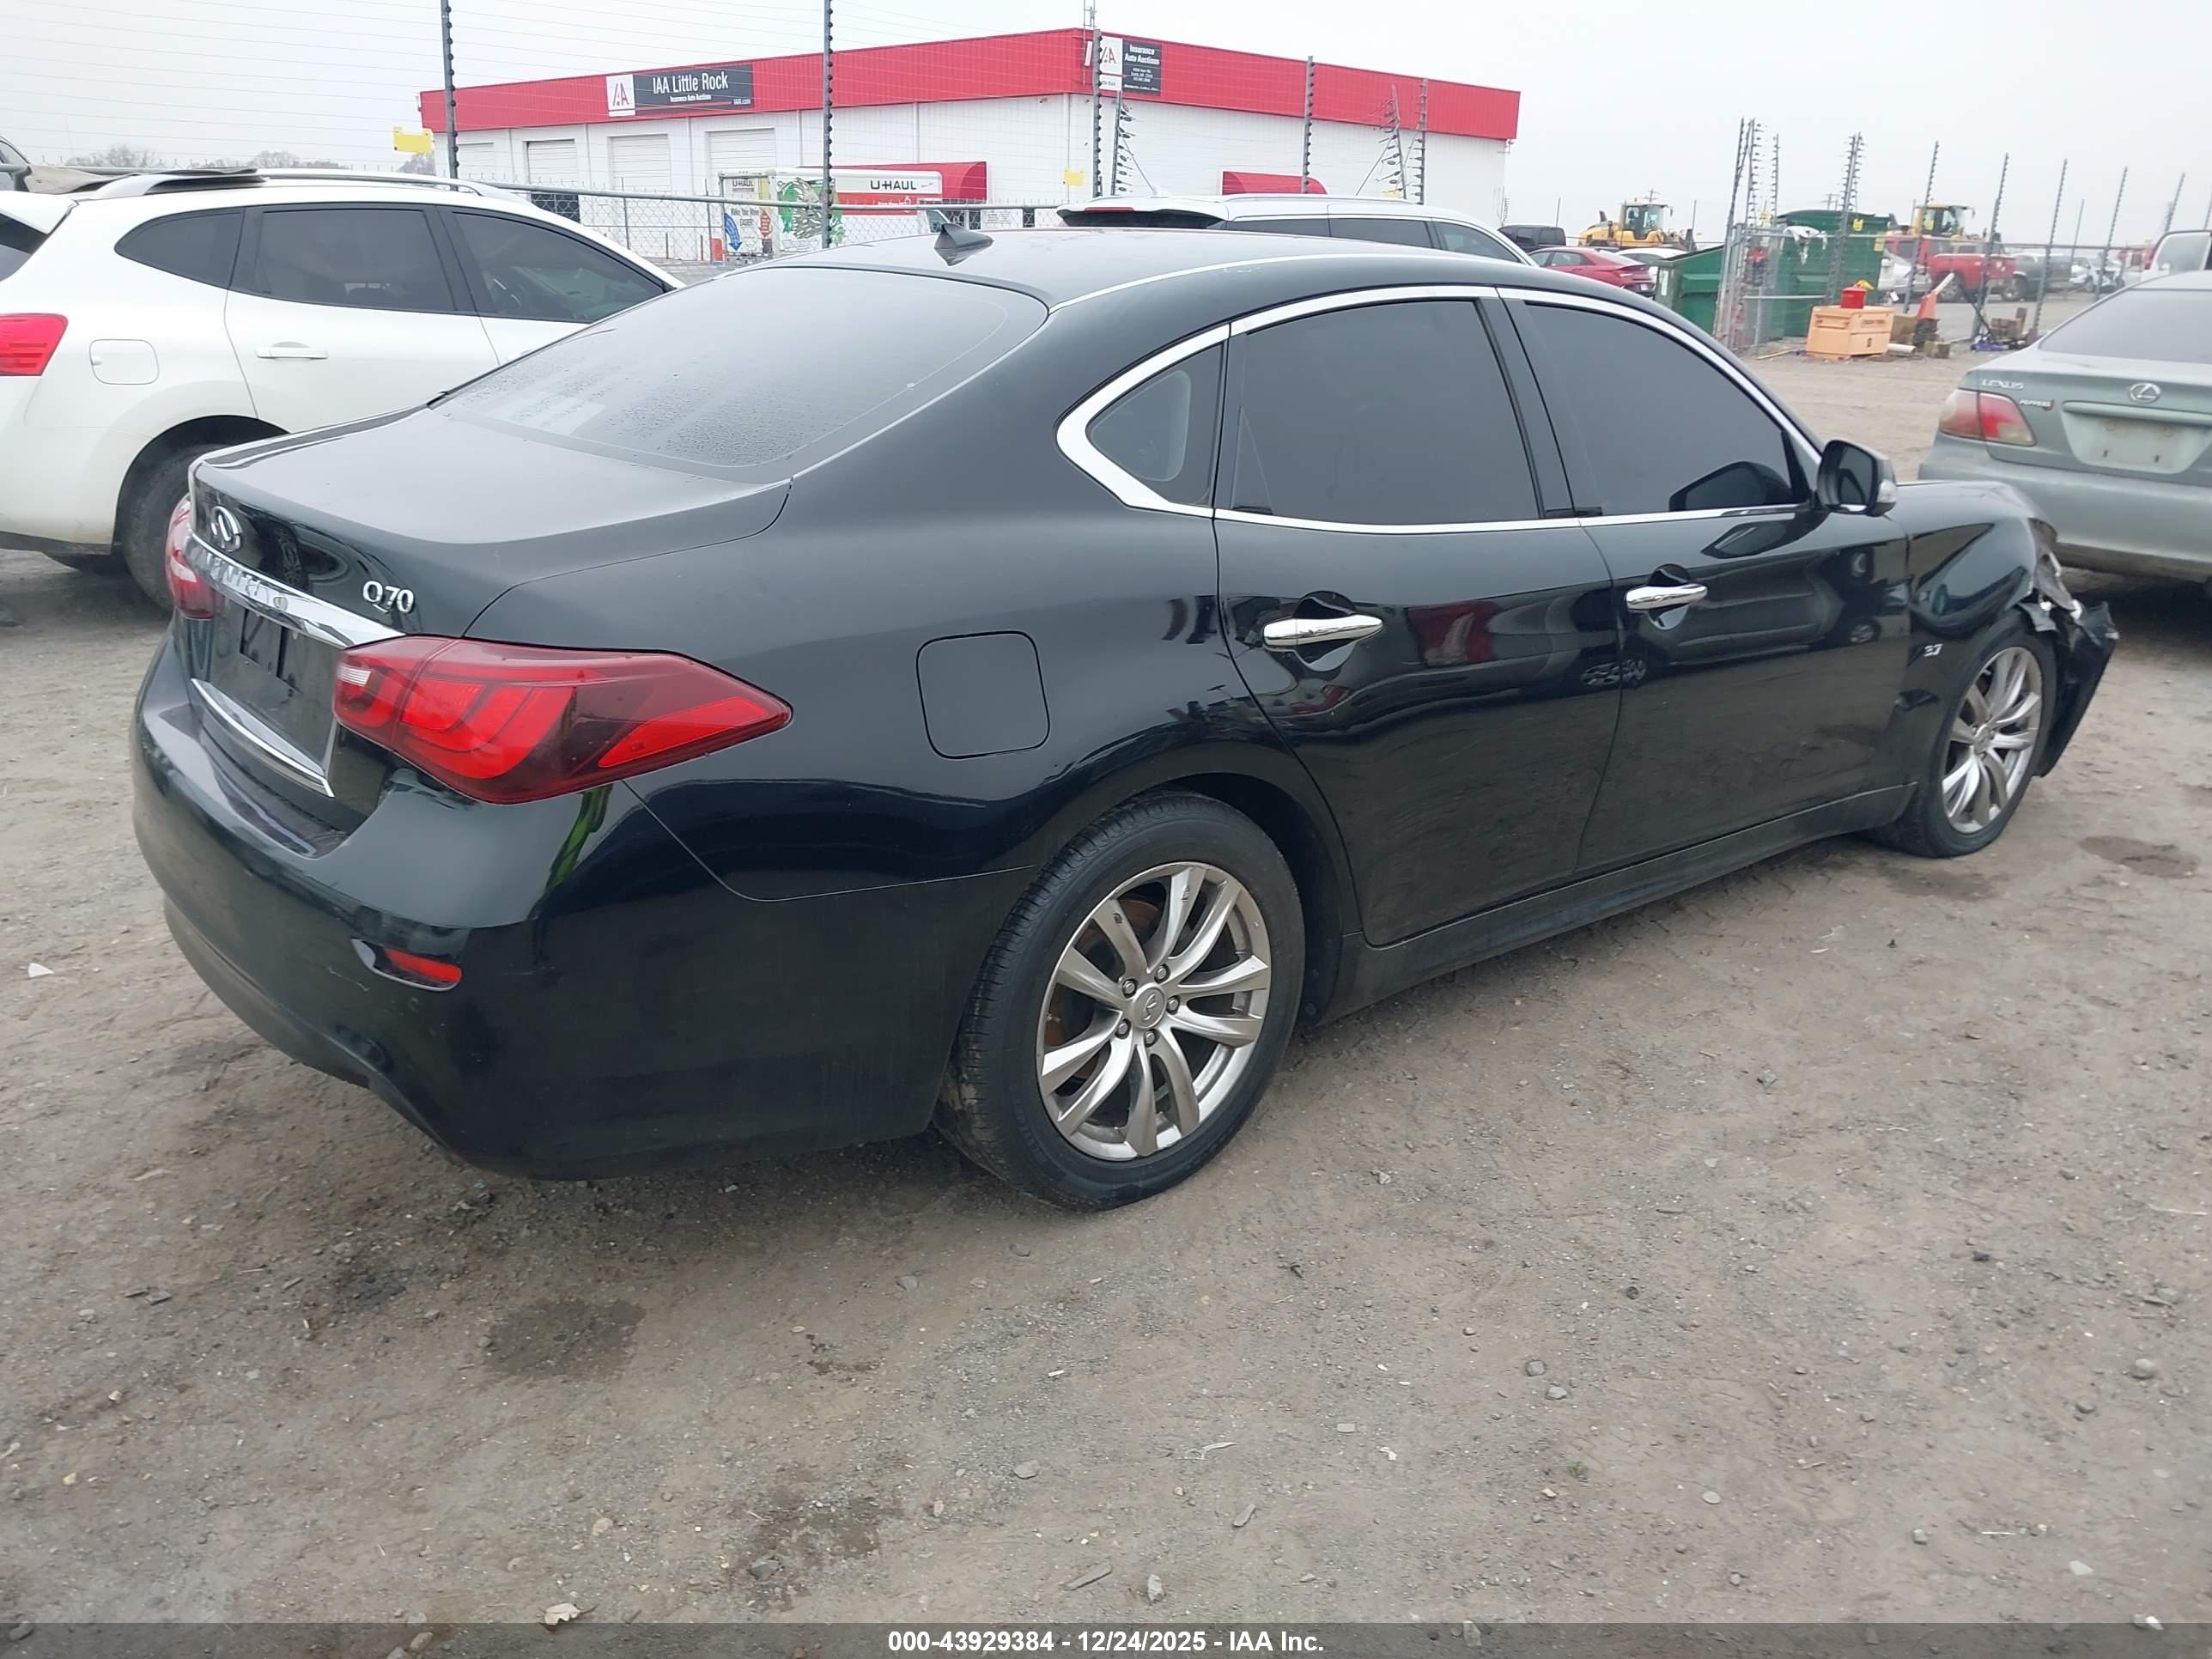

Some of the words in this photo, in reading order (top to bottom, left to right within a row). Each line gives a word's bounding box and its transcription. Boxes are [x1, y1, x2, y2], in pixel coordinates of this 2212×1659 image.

[653, 76, 670, 94] IAA
[672, 74, 699, 93] Little
[702, 70, 729, 90] Rock
[870, 179, 917, 190] U-HAUL
[1982, 379, 2025, 390] LEXUS
[362, 580, 415, 613] Q70
